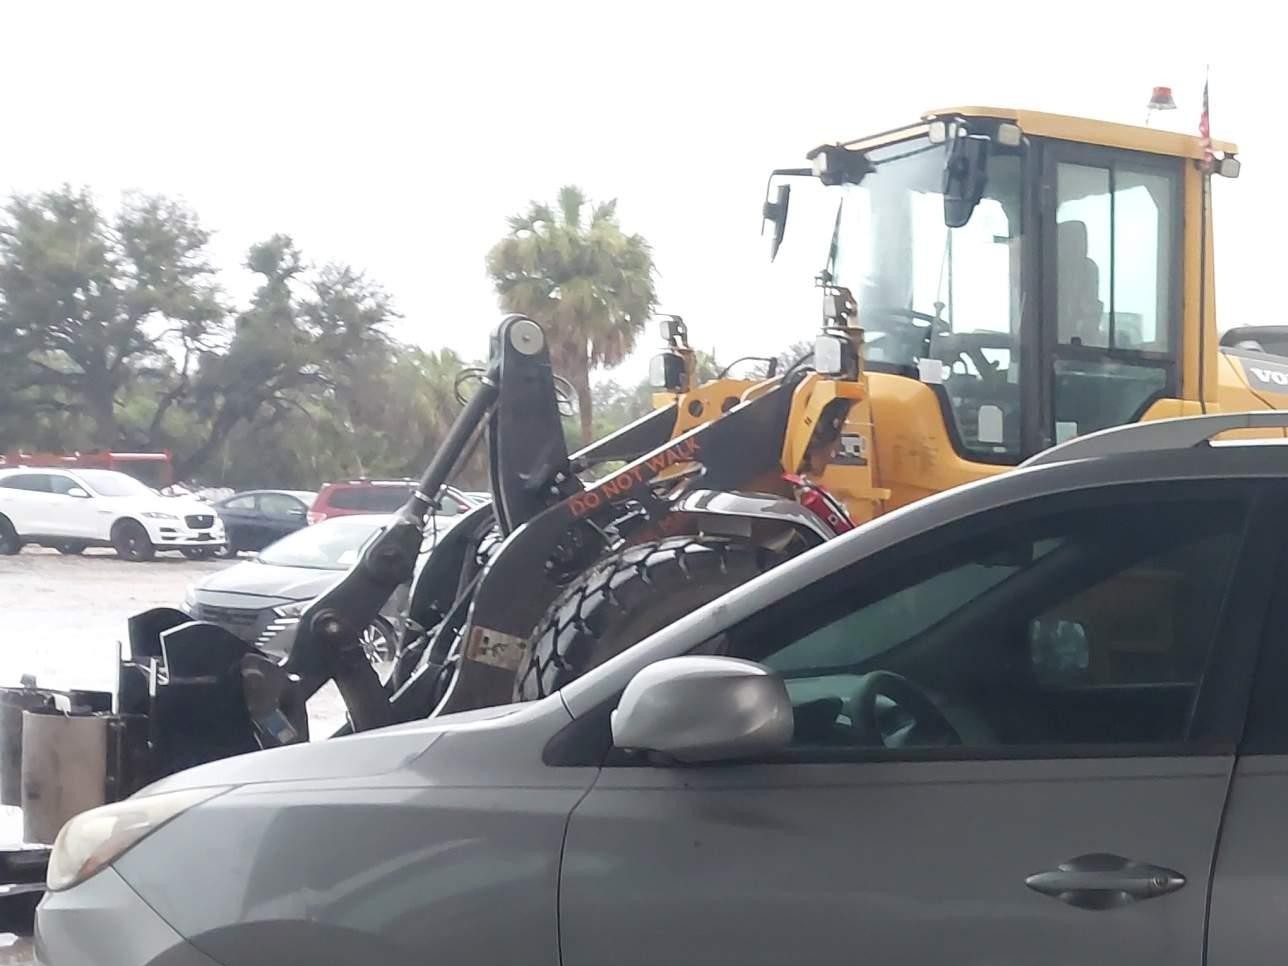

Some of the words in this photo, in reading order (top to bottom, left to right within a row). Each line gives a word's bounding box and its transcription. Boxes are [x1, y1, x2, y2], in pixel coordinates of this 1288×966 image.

[569, 493, 599, 516] DO
[602, 467, 642, 498] NOT
[646, 438, 700, 472] WALK
